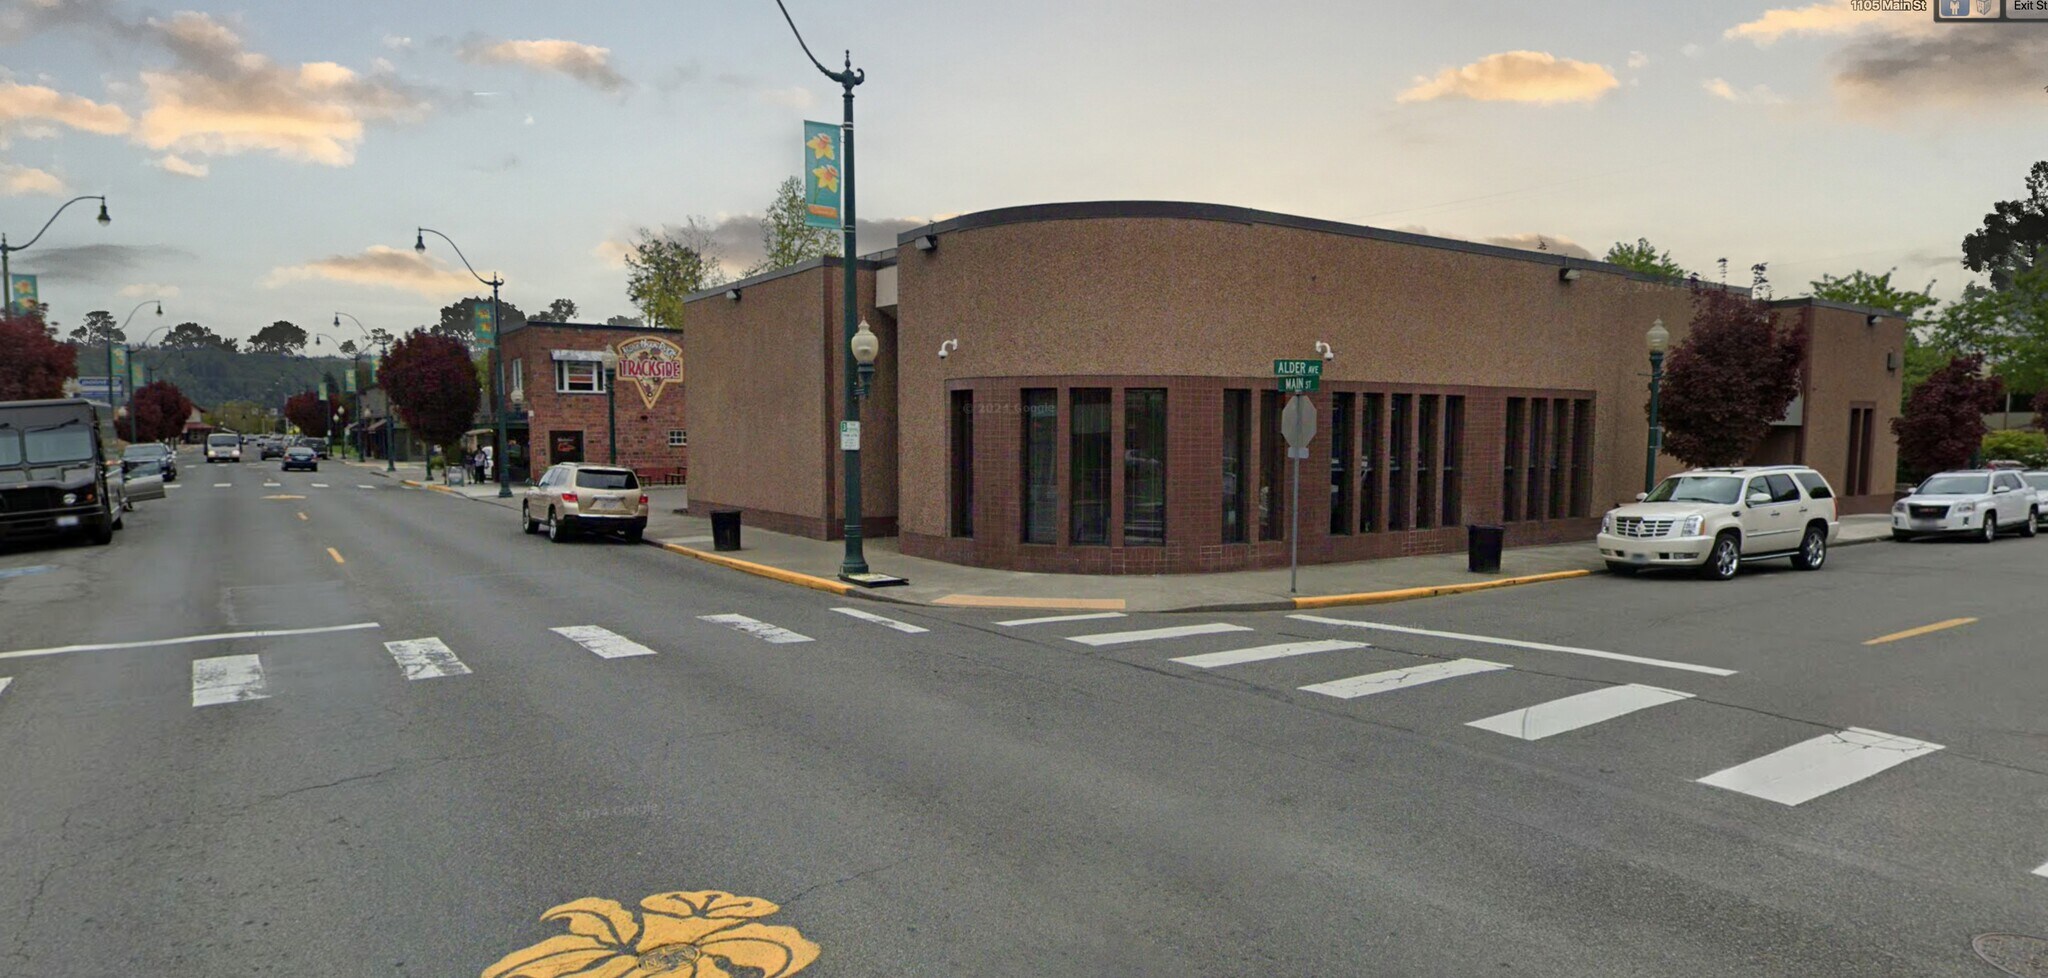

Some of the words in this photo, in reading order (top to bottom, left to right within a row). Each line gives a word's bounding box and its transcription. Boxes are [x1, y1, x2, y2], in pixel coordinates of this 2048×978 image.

[1278, 361, 1306, 374] ALDER
[1308, 365, 1319, 374] AVE
[1285, 378, 1304, 390] MAIN
[1305, 380, 1312, 389] ST
